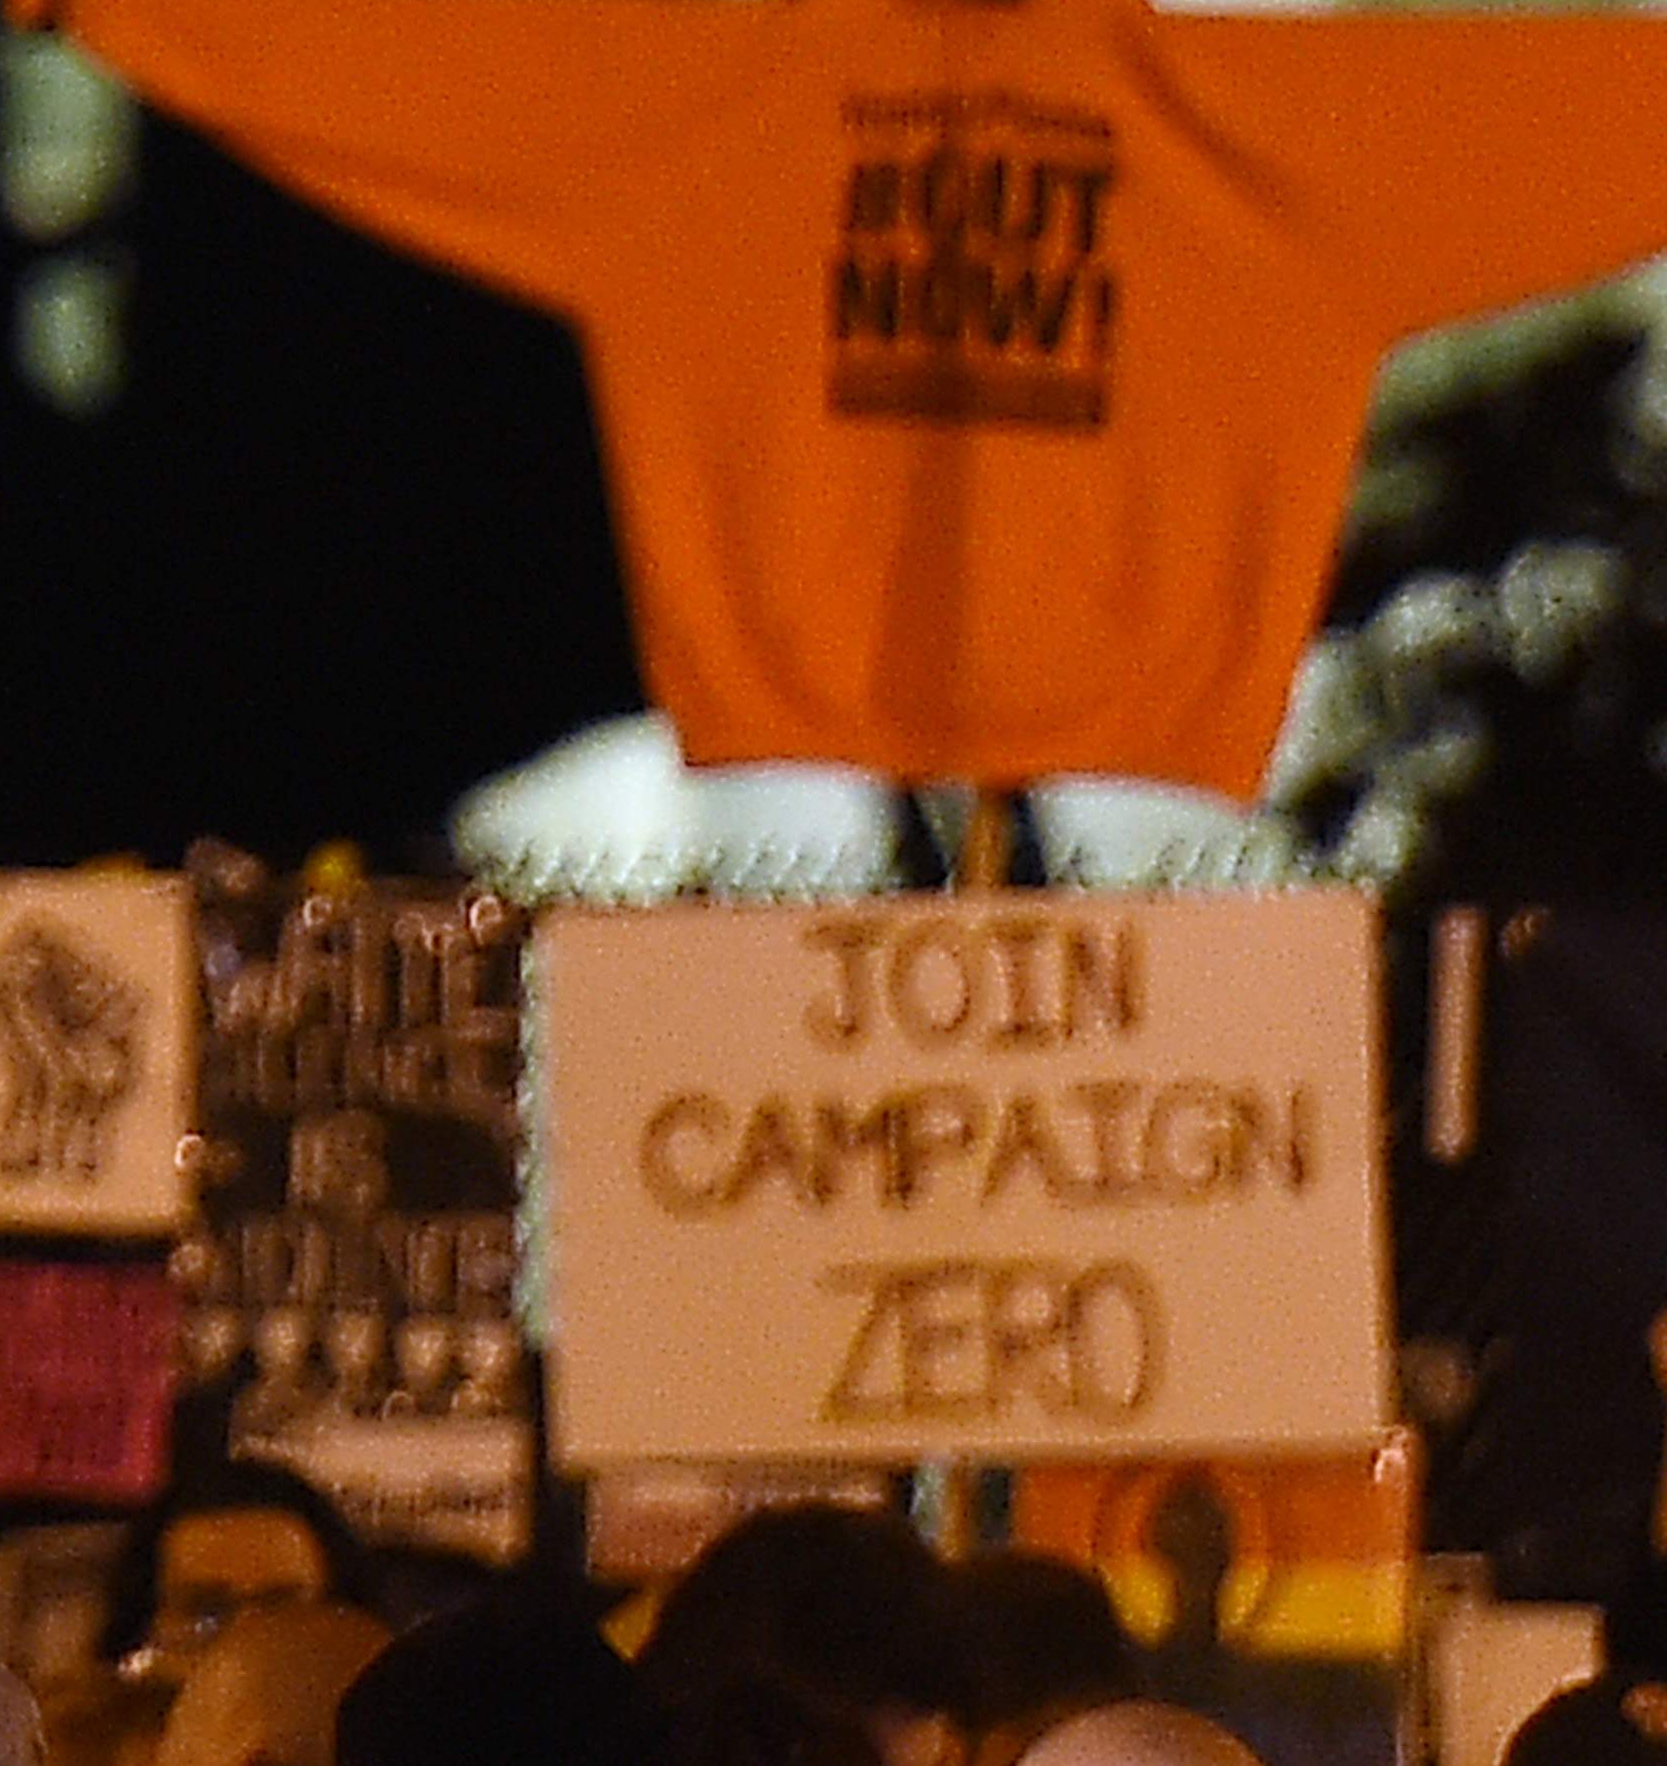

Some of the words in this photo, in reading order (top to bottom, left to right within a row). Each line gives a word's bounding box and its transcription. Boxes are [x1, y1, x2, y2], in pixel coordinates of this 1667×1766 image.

[832, 260, 1113, 356] NOW!
[801, 914, 1145, 1052] JOIN
[637, 1077, 1317, 1219] CAMPAIGN
[814, 1254, 1170, 1426] ZERO
